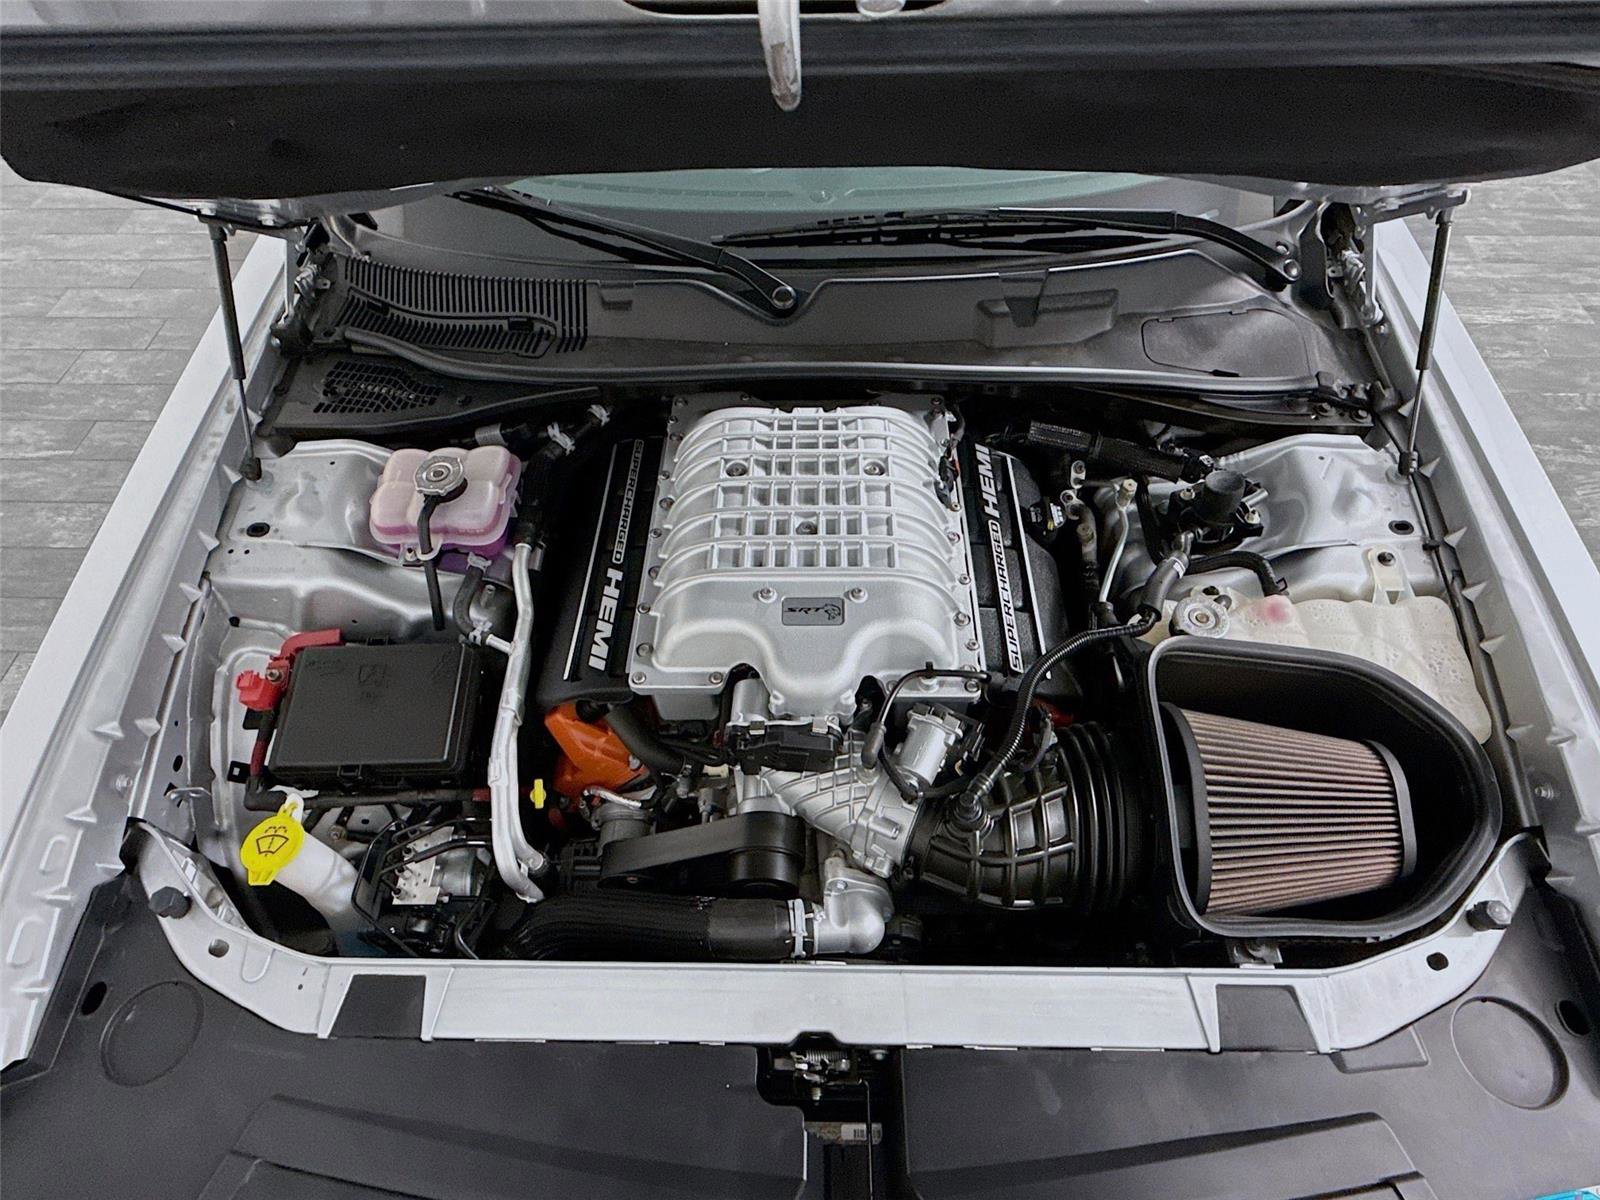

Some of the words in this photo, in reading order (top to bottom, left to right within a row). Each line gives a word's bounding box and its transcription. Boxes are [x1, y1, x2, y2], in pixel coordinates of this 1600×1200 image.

[613, 439, 644, 564] SUPERCHARGED
[974, 443, 1000, 519] HEMI
[588, 567, 624, 671] HEMI
[785, 606, 824, 615] SRT
[989, 520, 1023, 672] SUPERCHARGED
